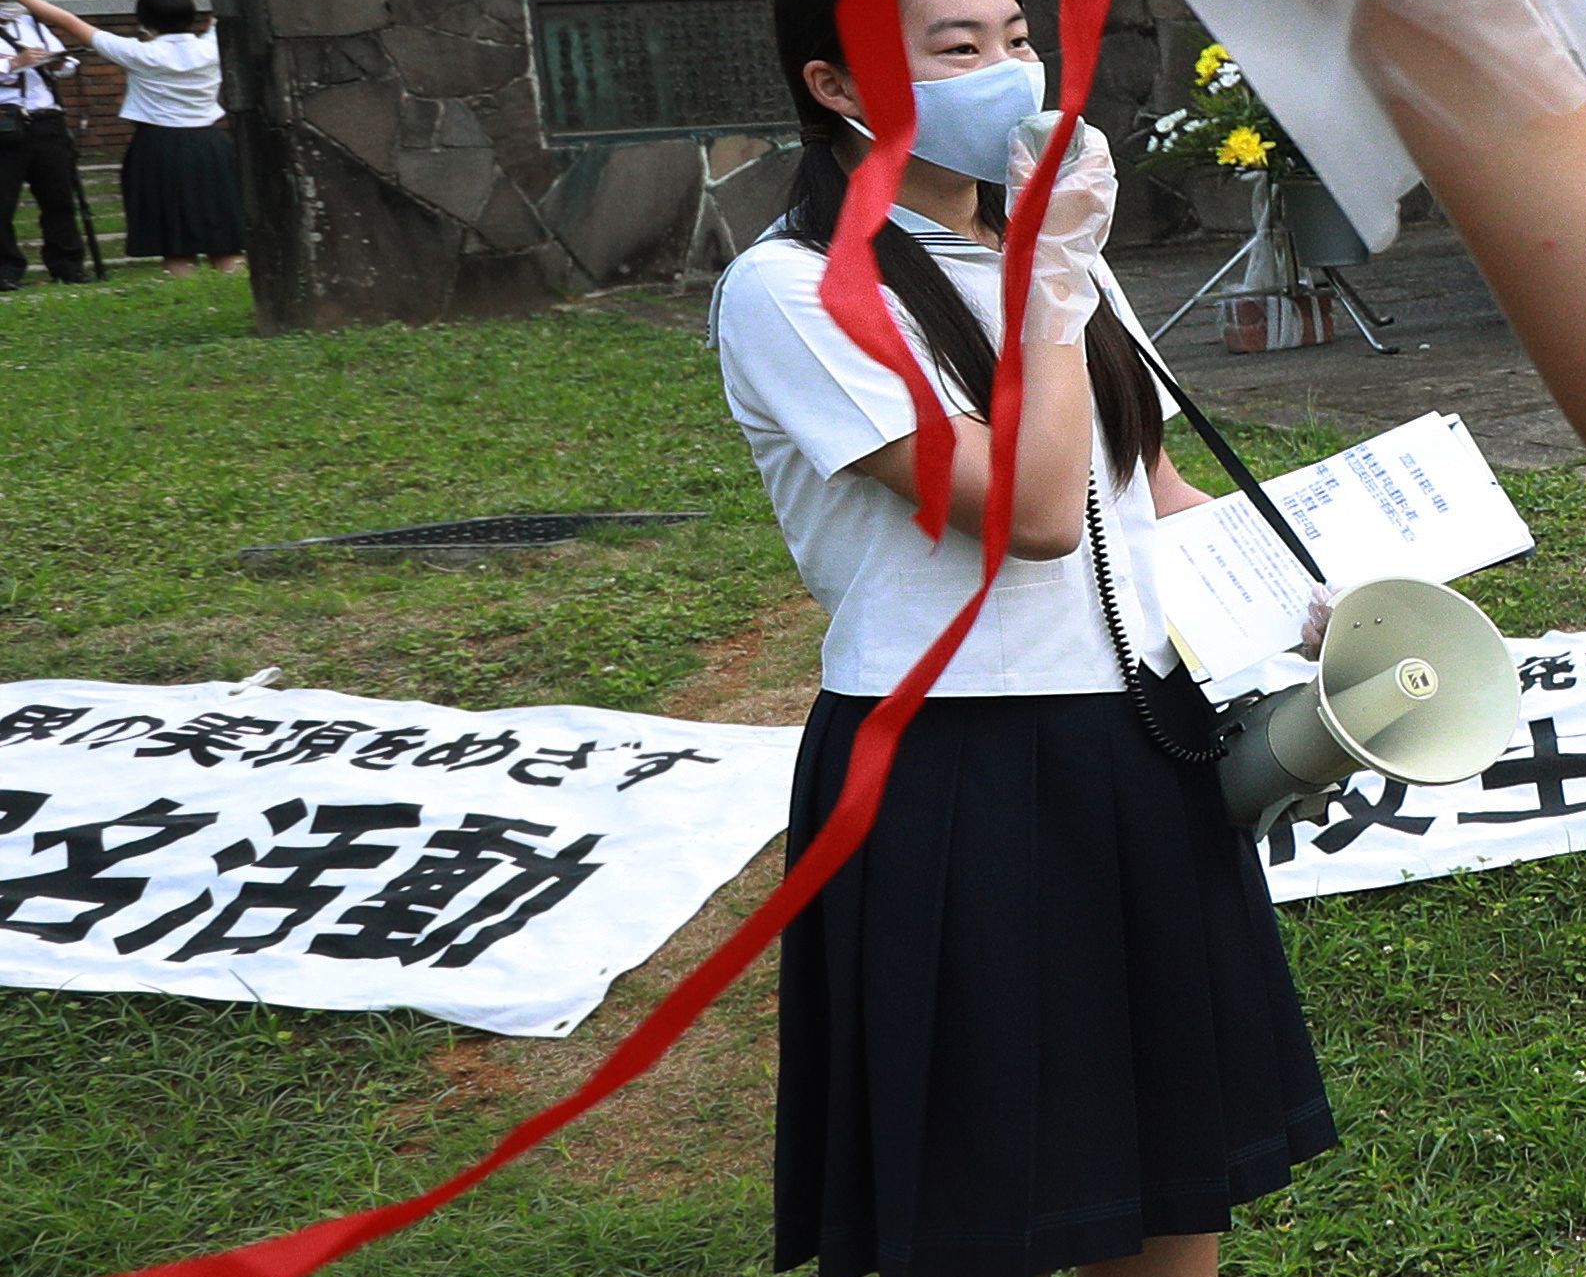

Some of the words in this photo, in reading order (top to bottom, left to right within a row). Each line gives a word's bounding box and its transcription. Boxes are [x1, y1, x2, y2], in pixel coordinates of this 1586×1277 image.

[0, 704, 721, 791] 界の実現をめざす
[0, 789, 606, 969] 名活動
